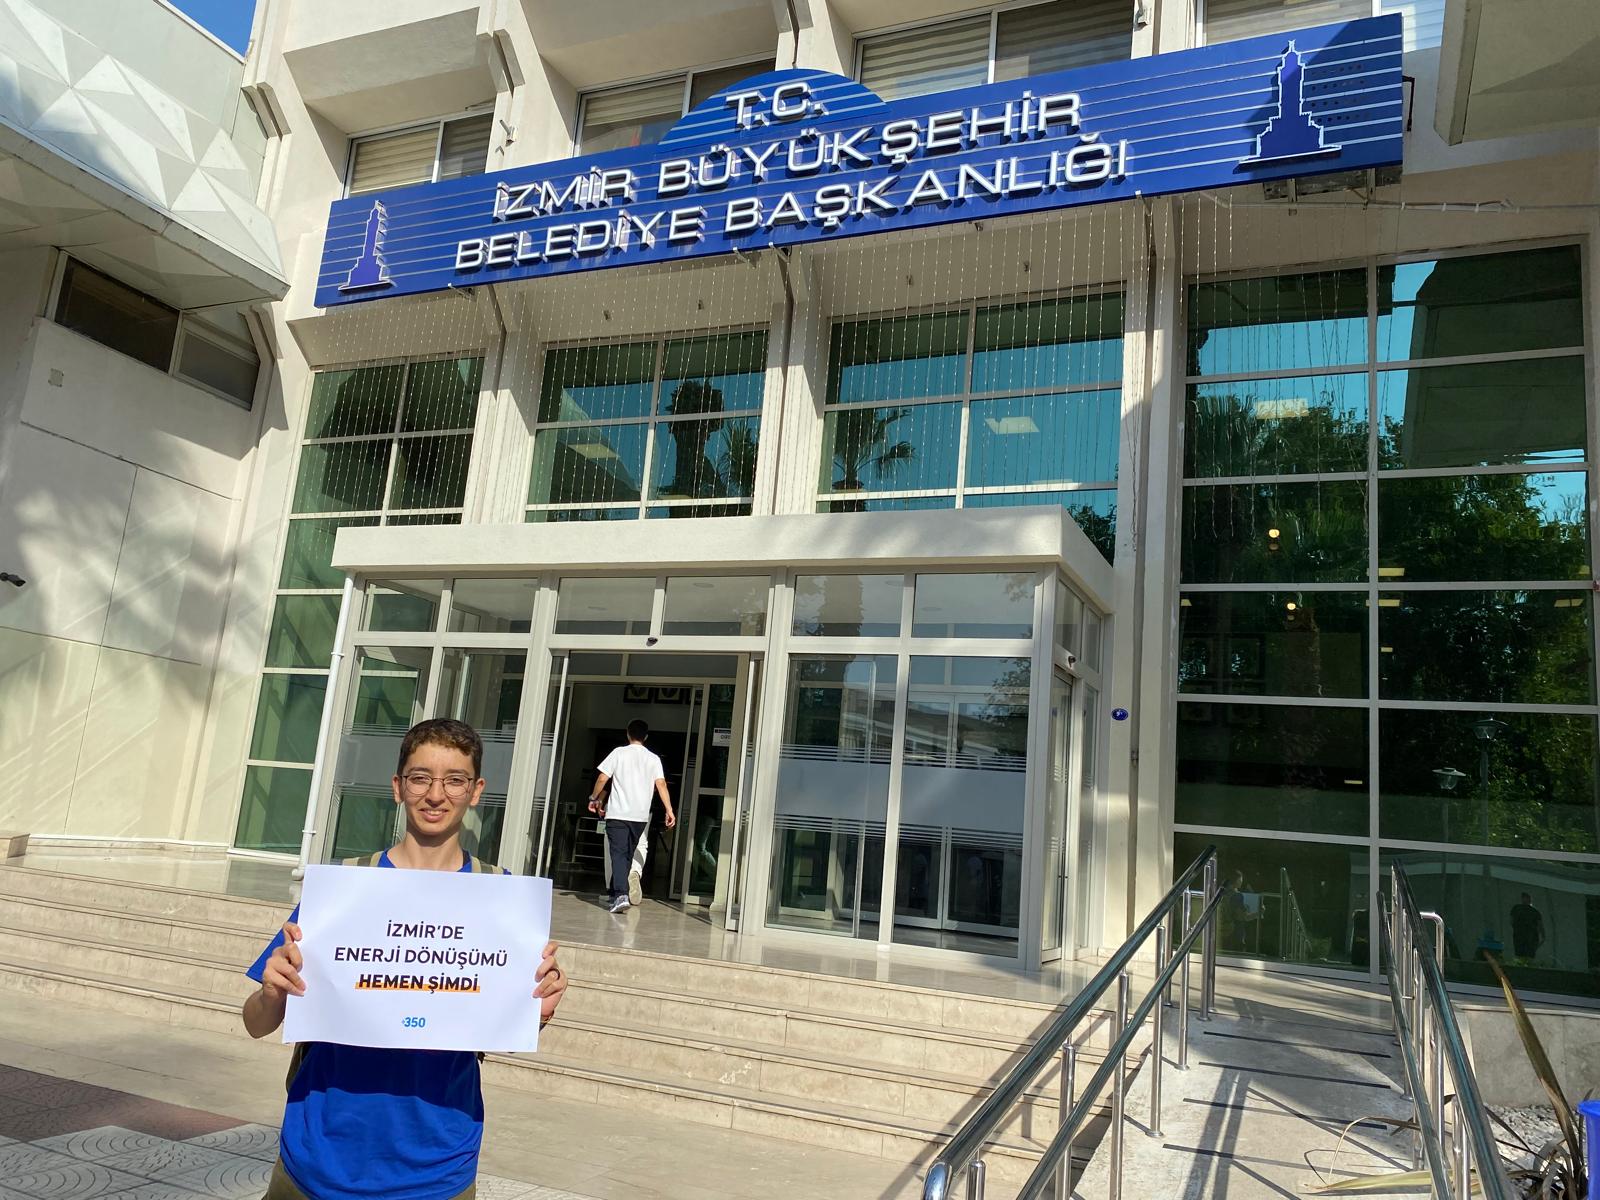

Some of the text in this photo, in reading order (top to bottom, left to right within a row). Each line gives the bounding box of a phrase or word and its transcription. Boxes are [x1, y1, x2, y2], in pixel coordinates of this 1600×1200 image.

[726, 81, 825, 129] T.C.
[493, 90, 1081, 220] İZMİR BÜYÜK ŞEHİR
[455, 132, 1128, 269] BELEDİYE BAŞKANLIĞI
[386, 919, 465, 940] İZMİR'DE
[334, 945, 508, 970] ENERJİ DÖNÜŞÜMÜ
[358, 972, 479, 994] HEMEN ŞİMDİ
